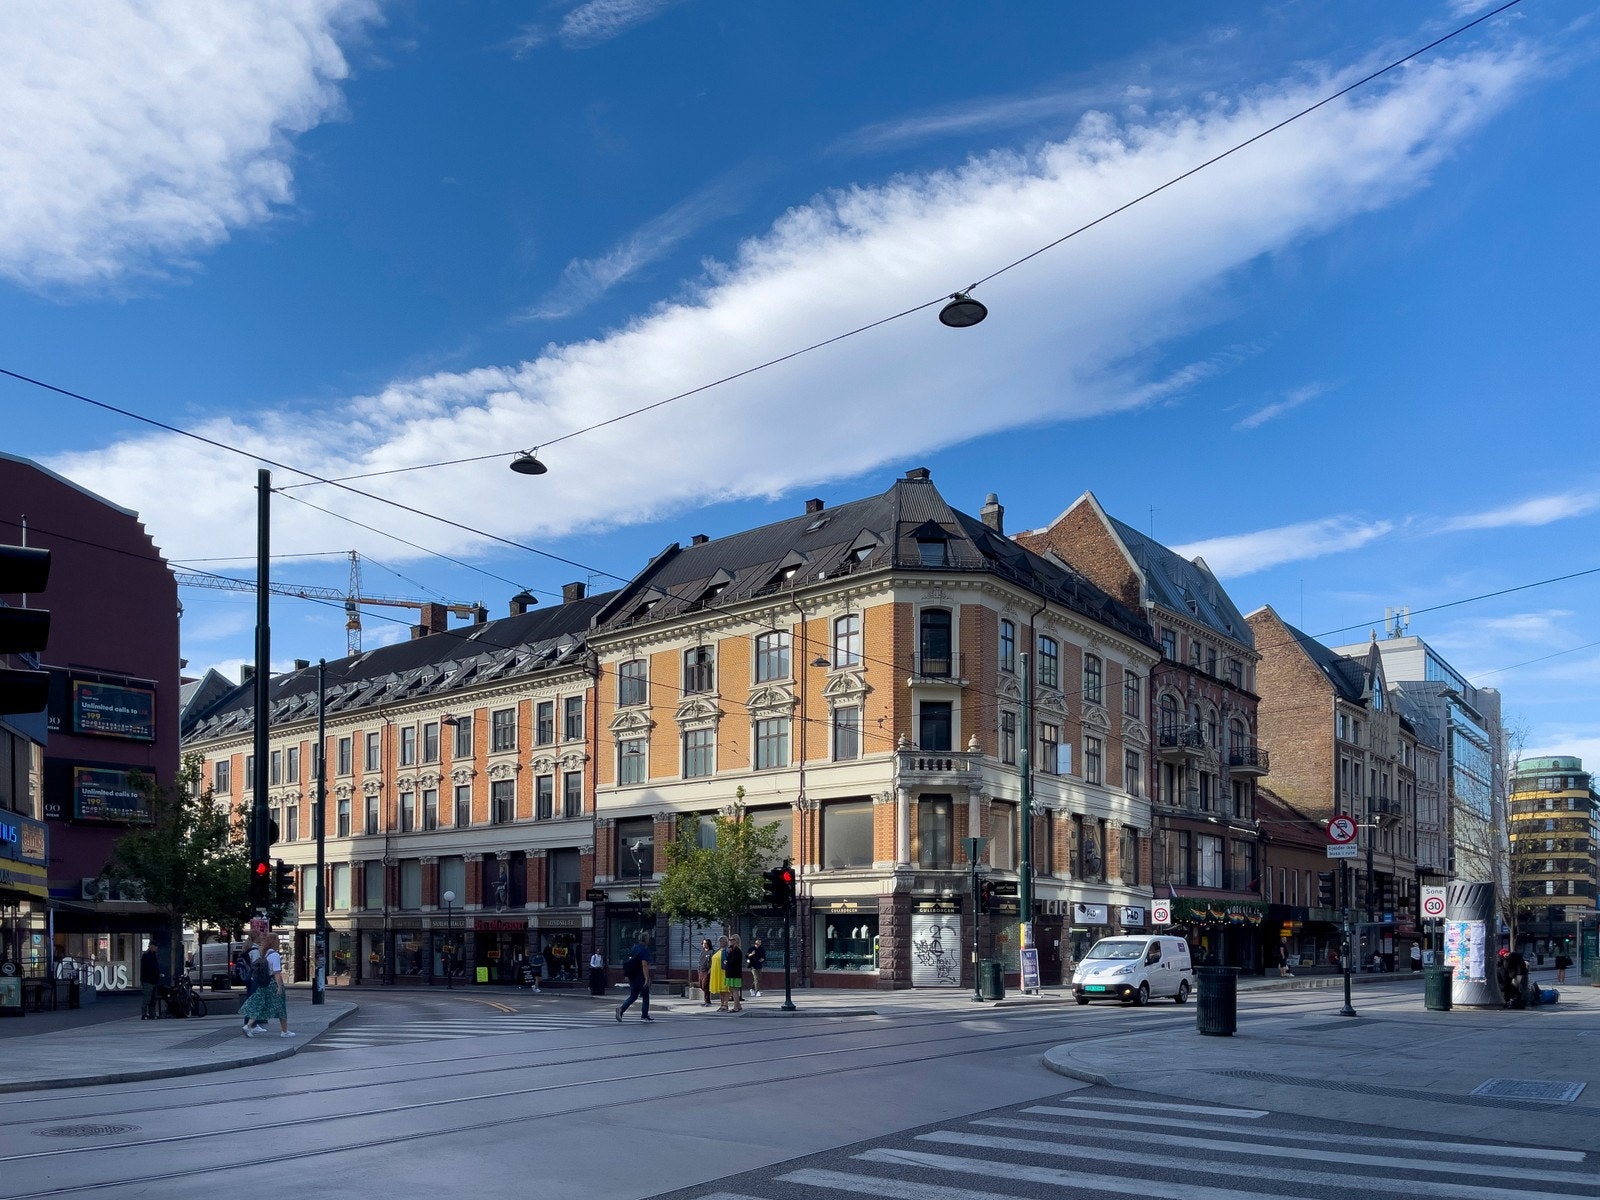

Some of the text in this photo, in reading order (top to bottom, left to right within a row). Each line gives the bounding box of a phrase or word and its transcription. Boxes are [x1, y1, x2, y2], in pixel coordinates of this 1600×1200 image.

[82, 702, 114, 712] Unlimited
[114, 706, 130, 714] calls
[82, 788, 114, 797] Unlimited
[1428, 901, 1441, 910] 30
